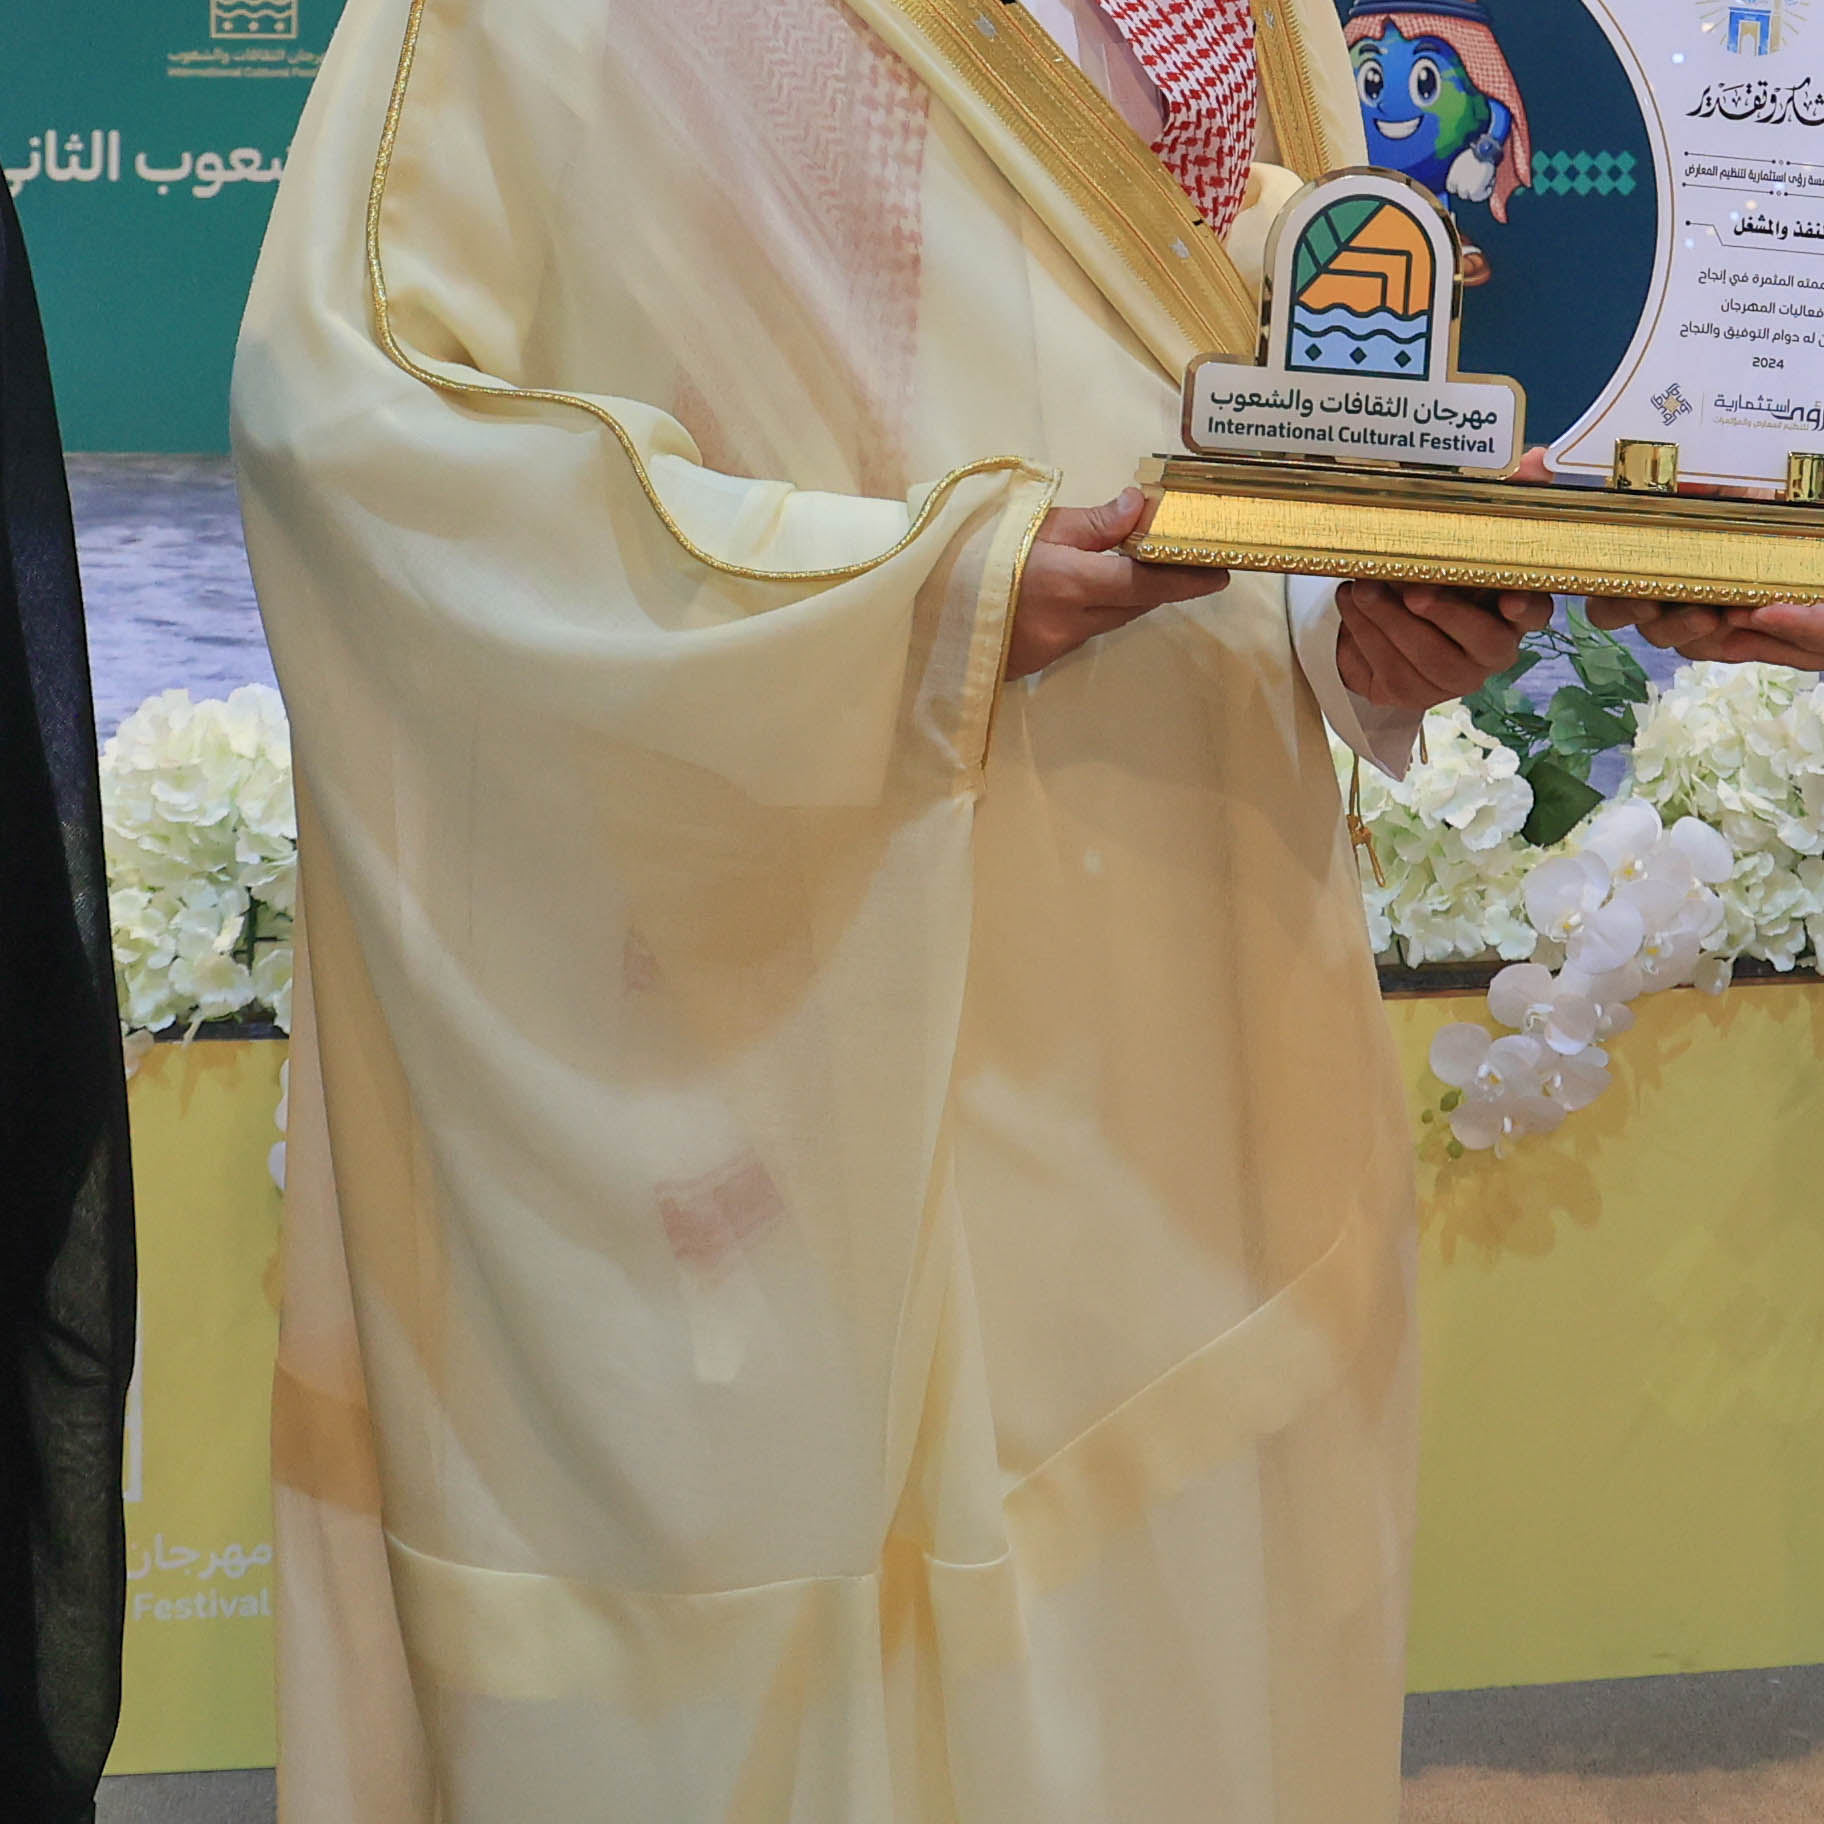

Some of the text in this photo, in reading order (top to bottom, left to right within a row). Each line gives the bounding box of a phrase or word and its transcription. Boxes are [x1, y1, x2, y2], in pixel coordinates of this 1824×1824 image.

[1734, 214, 1789, 240] والمشغل
[1698, 267, 1727, 284] إنجاح
[1729, 271, 1749, 286] في
[1752, 272, 1794, 287] المثمرة
[1721, 298, 1824, 318] فعاليات المهرجان
[1680, 320, 1720, 338] والنجاح
[1724, 325, 1770, 340] التوفيق
[1772, 330, 1800, 345] دوام
[1803, 332, 1816, 344] له
[1752, 356, 1785, 369] 2024
[1210, 388, 1498, 430] مهرجان الثقافات والشعوب
[1714, 393, 1791, 414] استثمارية
[1208, 416, 1496, 454] International Cultural Festival
[127, 1532, 273, 1580] مهرجان
[133, 1587, 273, 1621] Festival
